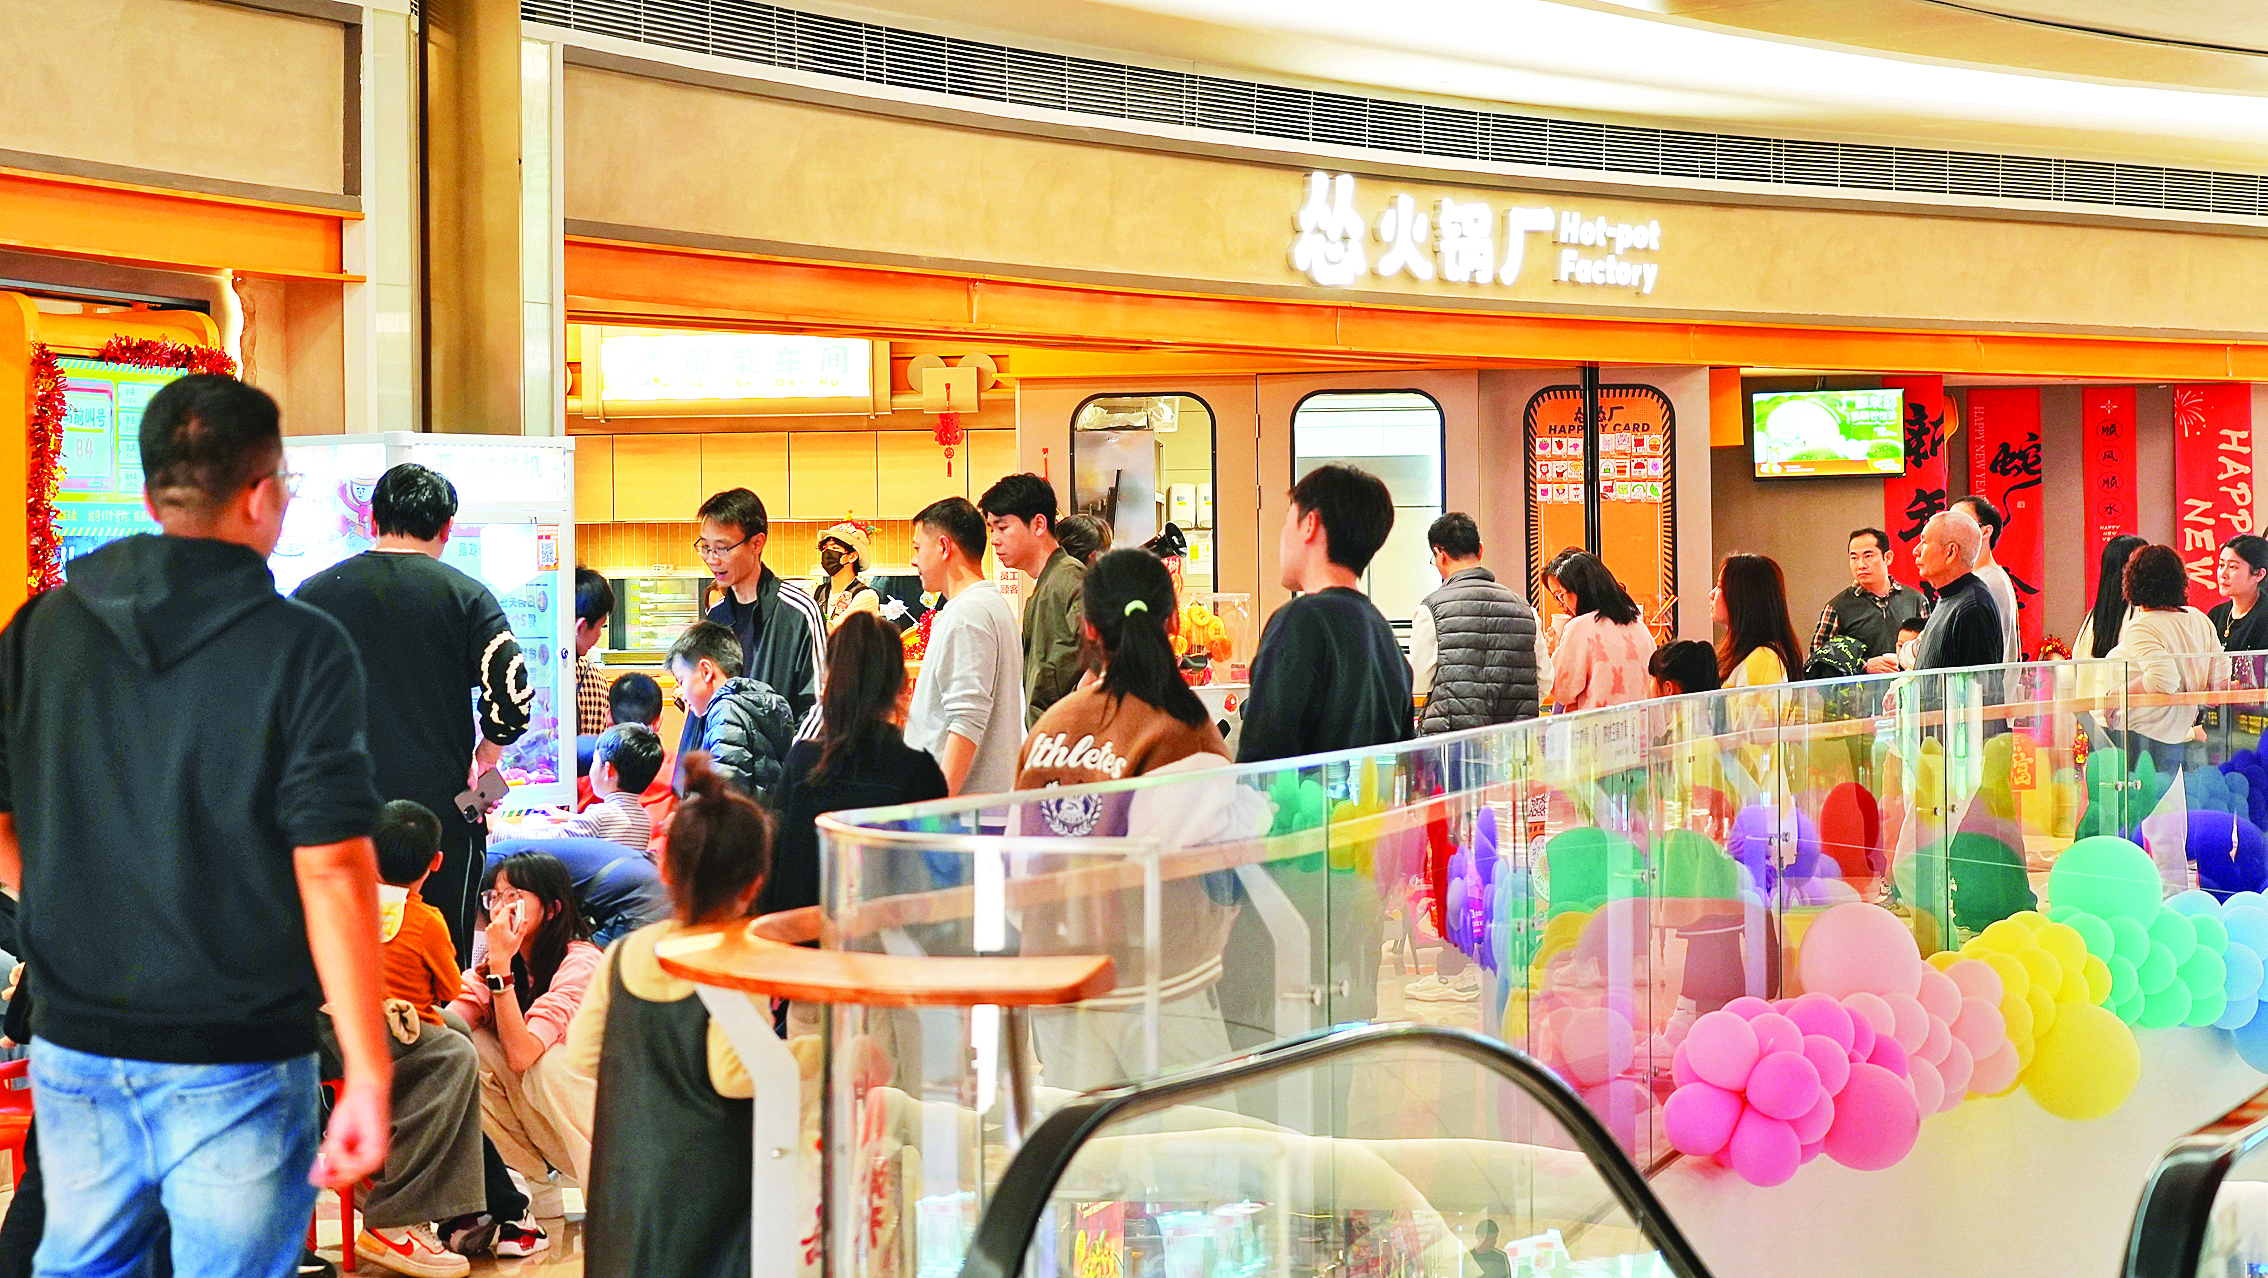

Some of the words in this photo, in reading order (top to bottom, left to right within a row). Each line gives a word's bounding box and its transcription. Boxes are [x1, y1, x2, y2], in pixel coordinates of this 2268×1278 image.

[1289, 170, 1556, 286] 怂火锅厂
[1560, 210, 1661, 255] Hot-pot
[1560, 248, 1660, 295] Factory
[685, 344, 849, 375] 配菜车间
[1612, 422, 1651, 432] CARD
[1974, 406, 1985, 441] HAPPY
[1975, 445, 1986, 470] NEW
[2101, 423, 2121, 515] 顺风顺水
[2217, 428, 2253, 549] HAPP
[2183, 498, 2218, 590] NEW
[1000, 571, 1019, 581] 员工
